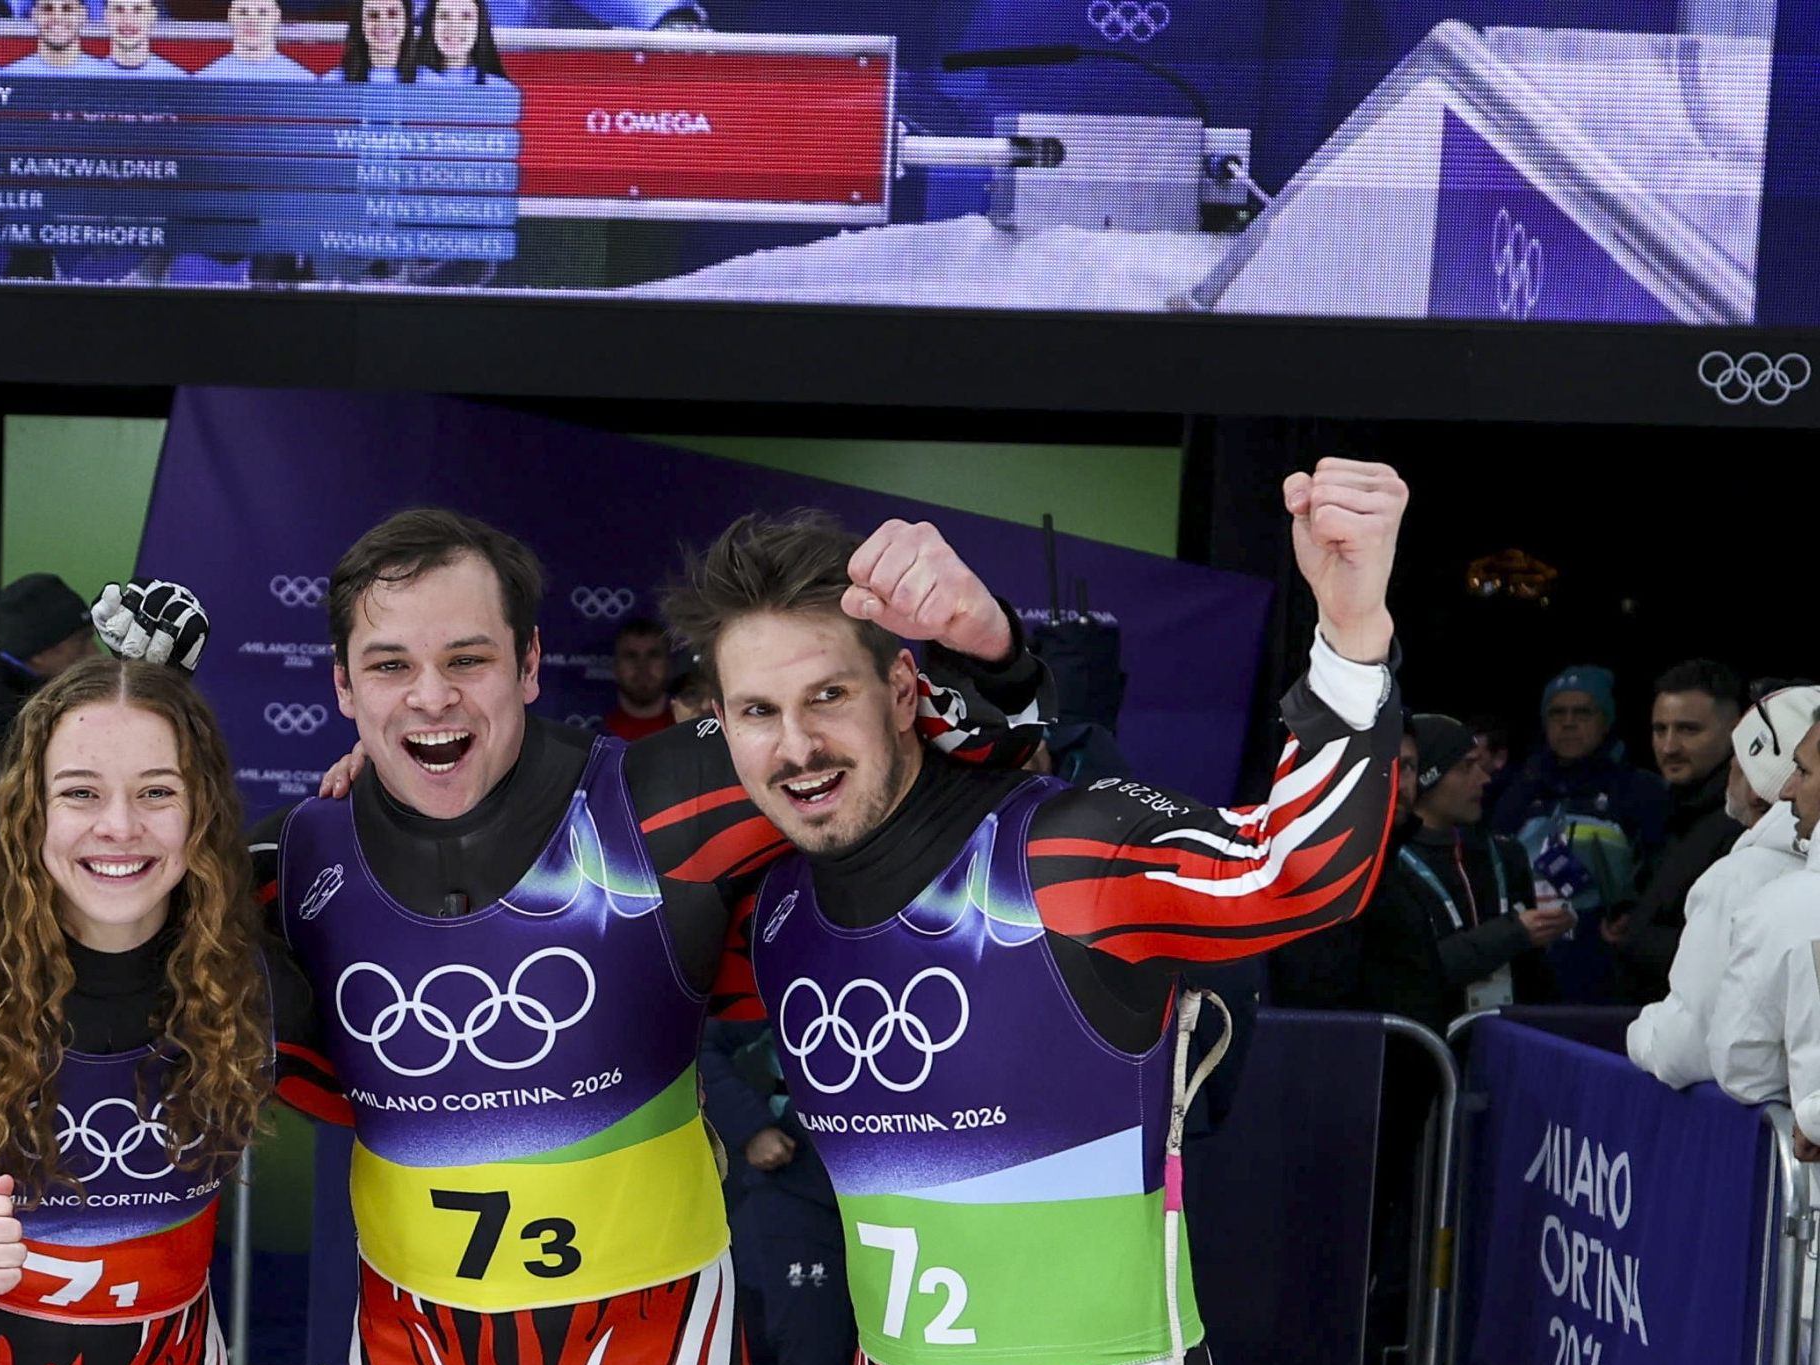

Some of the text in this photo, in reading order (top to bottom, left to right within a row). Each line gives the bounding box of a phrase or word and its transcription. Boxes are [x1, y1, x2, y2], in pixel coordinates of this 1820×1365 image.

[615, 112, 711, 134] OMEGA
[433, 131, 507, 153] SINGLES
[10, 157, 178, 178] KAINZWALDNER
[420, 165, 505, 185] DOUBLES
[429, 199, 503, 219] SINGLES
[39, 223, 165, 245] OBERHOFER
[418, 232, 502, 252] DOUBLES
[442, 1086, 566, 1112] CORTINA
[571, 1067, 623, 1099] 2026
[851, 1113, 949, 1133] CORTINA
[951, 1105, 1007, 1130] 2026
[86, 1191, 181, 1207] CORTINA
[185, 1177, 221, 1200] 2026
